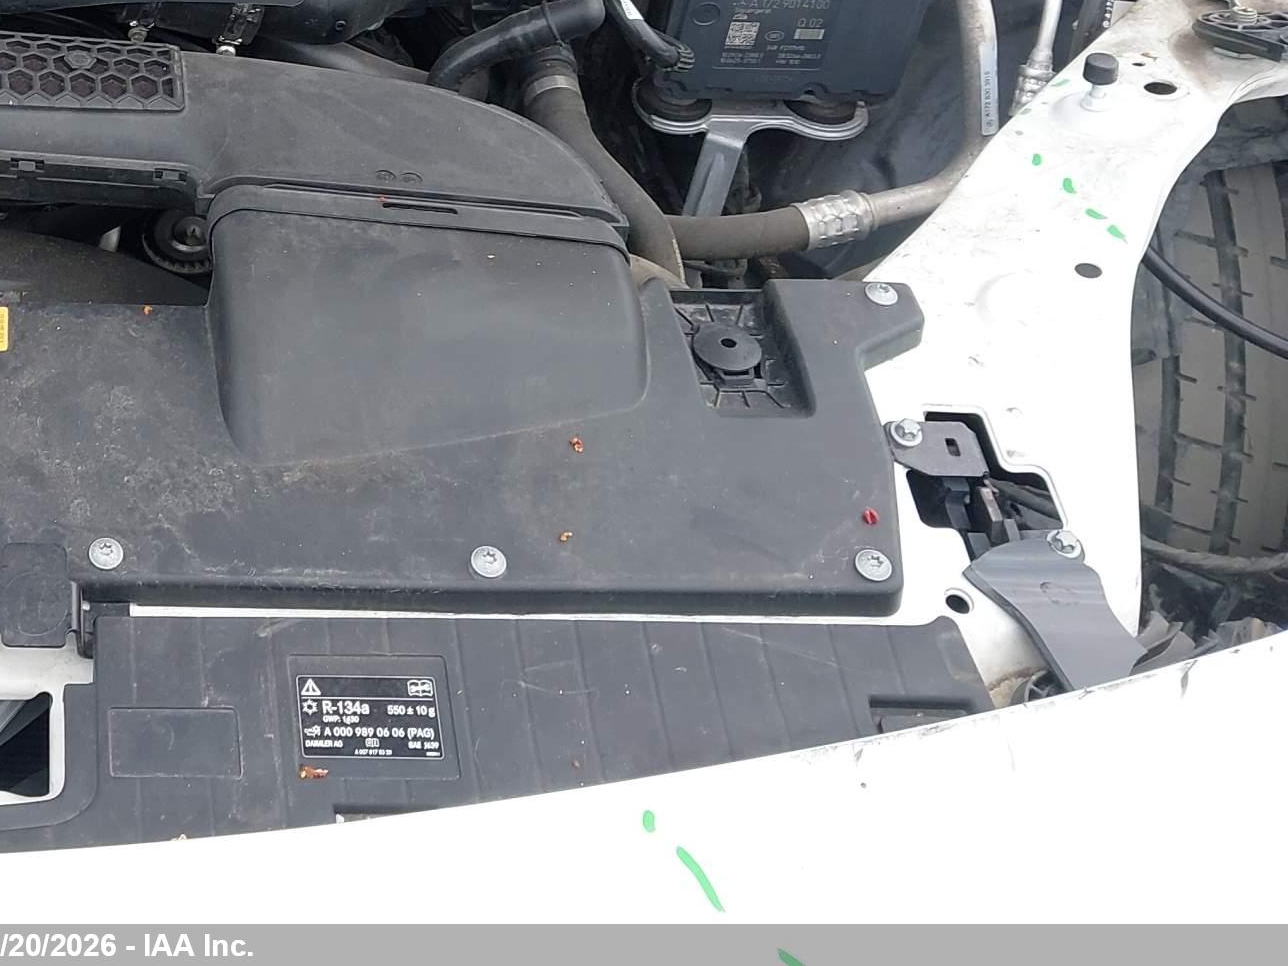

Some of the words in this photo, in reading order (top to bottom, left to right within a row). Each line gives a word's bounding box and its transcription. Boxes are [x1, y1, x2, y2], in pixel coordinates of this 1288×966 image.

[321, 700, 370, 715] R-134a
[387, 705, 406, 715] 550
[417, 705, 428, 715] 10
[428, 708, 435, 718] g
[324, 728, 332, 737] A
[333, 727, 353, 737] 000
[355, 727, 375, 737] 989
[376, 727, 390, 738] 06
[392, 728, 405, 738] 06
[407, 728, 434, 740] (PAG)
[305, 739, 333, 747] DAIMLER
[408, 741, 422, 749] SAE
